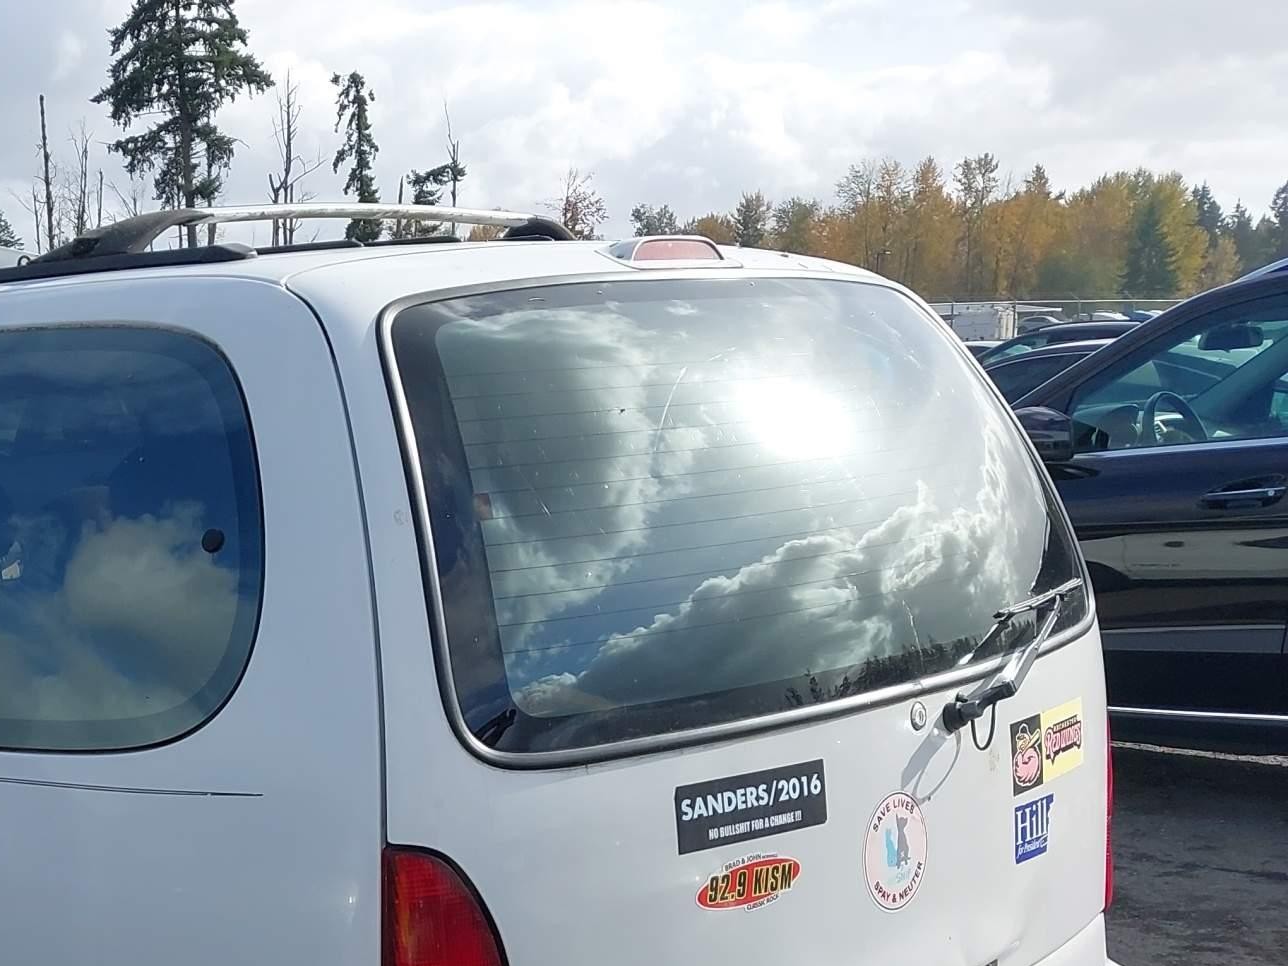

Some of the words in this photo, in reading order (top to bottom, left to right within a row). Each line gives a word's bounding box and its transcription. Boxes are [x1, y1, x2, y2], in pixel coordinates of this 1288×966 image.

[681, 773, 822, 821] SANDERS/2016
[872, 802, 891, 832] SAVE
[892, 797, 915, 815] LIVES
[708, 828, 719, 840] NO
[720, 821, 750, 837] BULLSHIT
[751, 819, 764, 832] FOR
[764, 817, 770, 828] A
[769, 813, 795, 827] CHANGE
[1016, 798, 1048, 845] Hill
[708, 870, 748, 904] 92.9
[753, 862, 793, 896] KISM
[724, 859, 741, 872] BRAD
[746, 853, 762, 863] JOHN
[874, 881, 891, 902] SPAY
[899, 861, 923, 901] NEUTER
